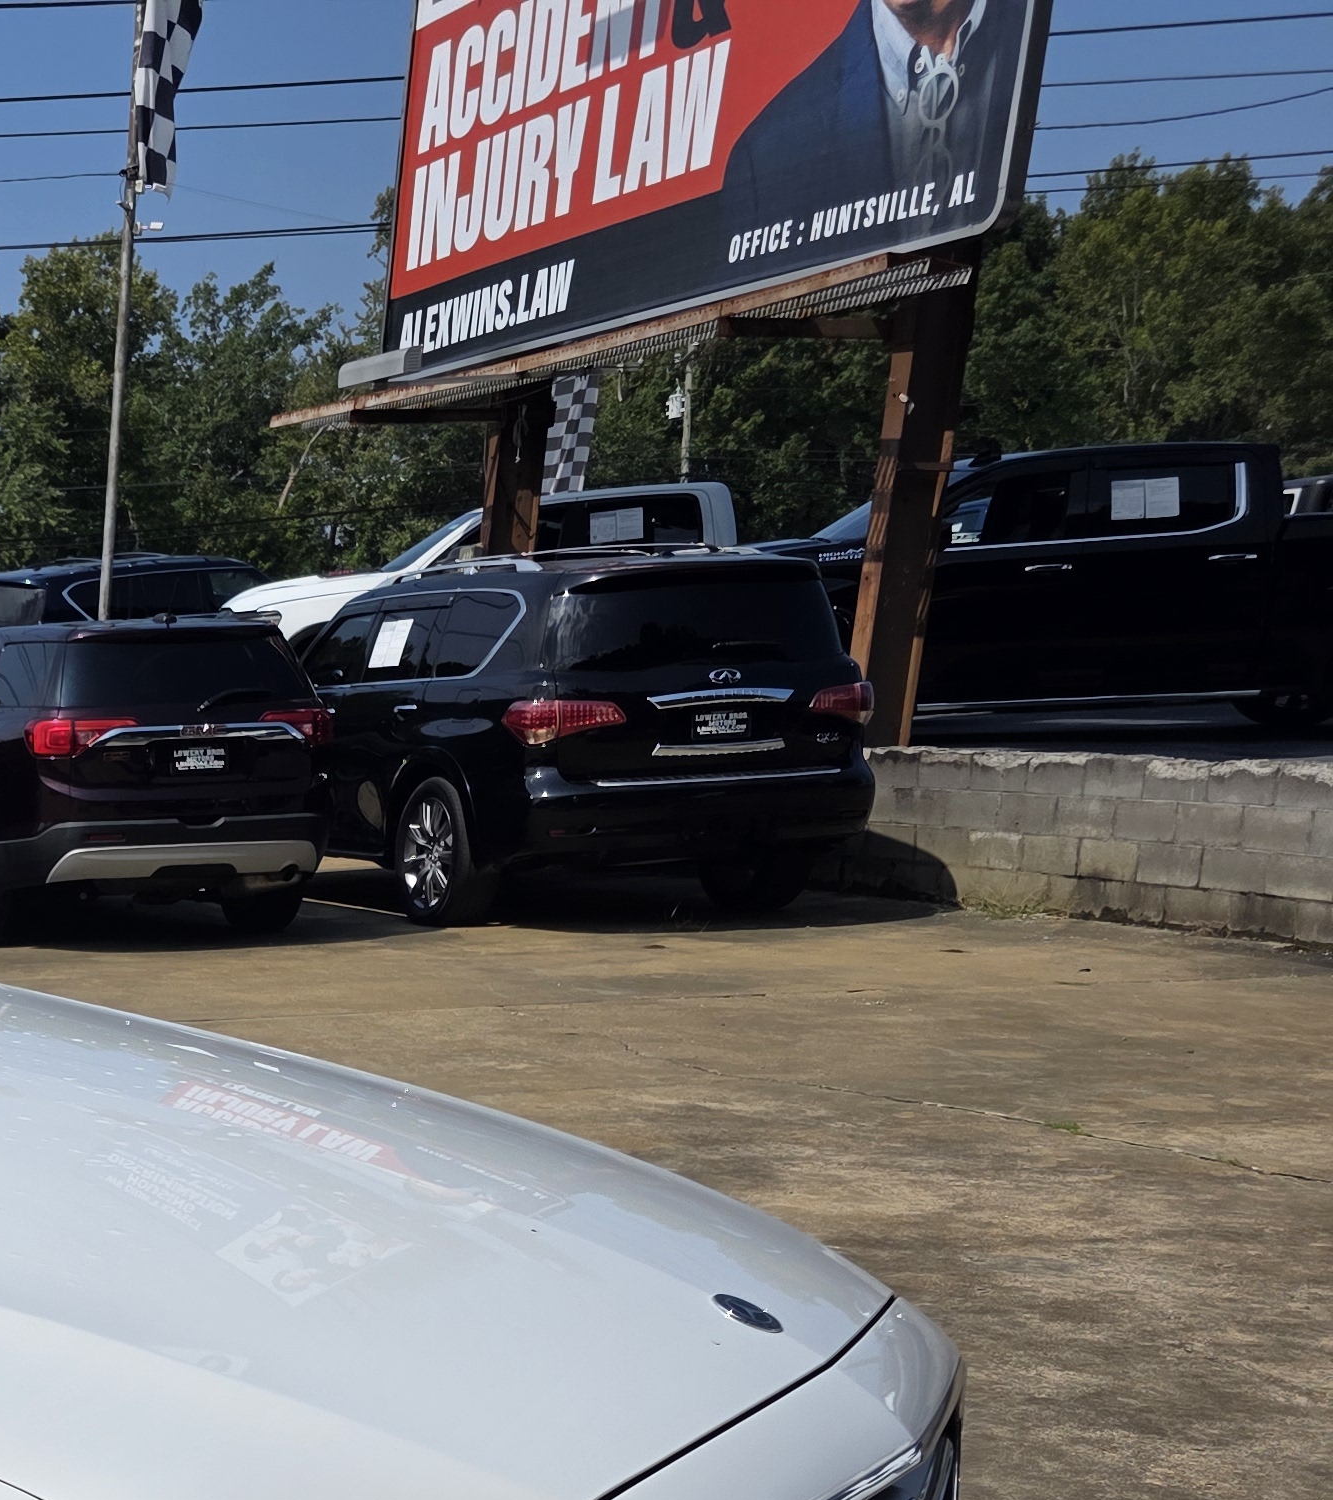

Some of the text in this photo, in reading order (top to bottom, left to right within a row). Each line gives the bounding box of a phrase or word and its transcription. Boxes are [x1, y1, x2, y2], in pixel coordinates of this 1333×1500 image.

[406, 38, 731, 271] INJURY LAW
[728, 219, 793, 264] OFFICE
[809, 181, 940, 242] HUNTSVILLE,
[948, 171, 976, 208] AL
